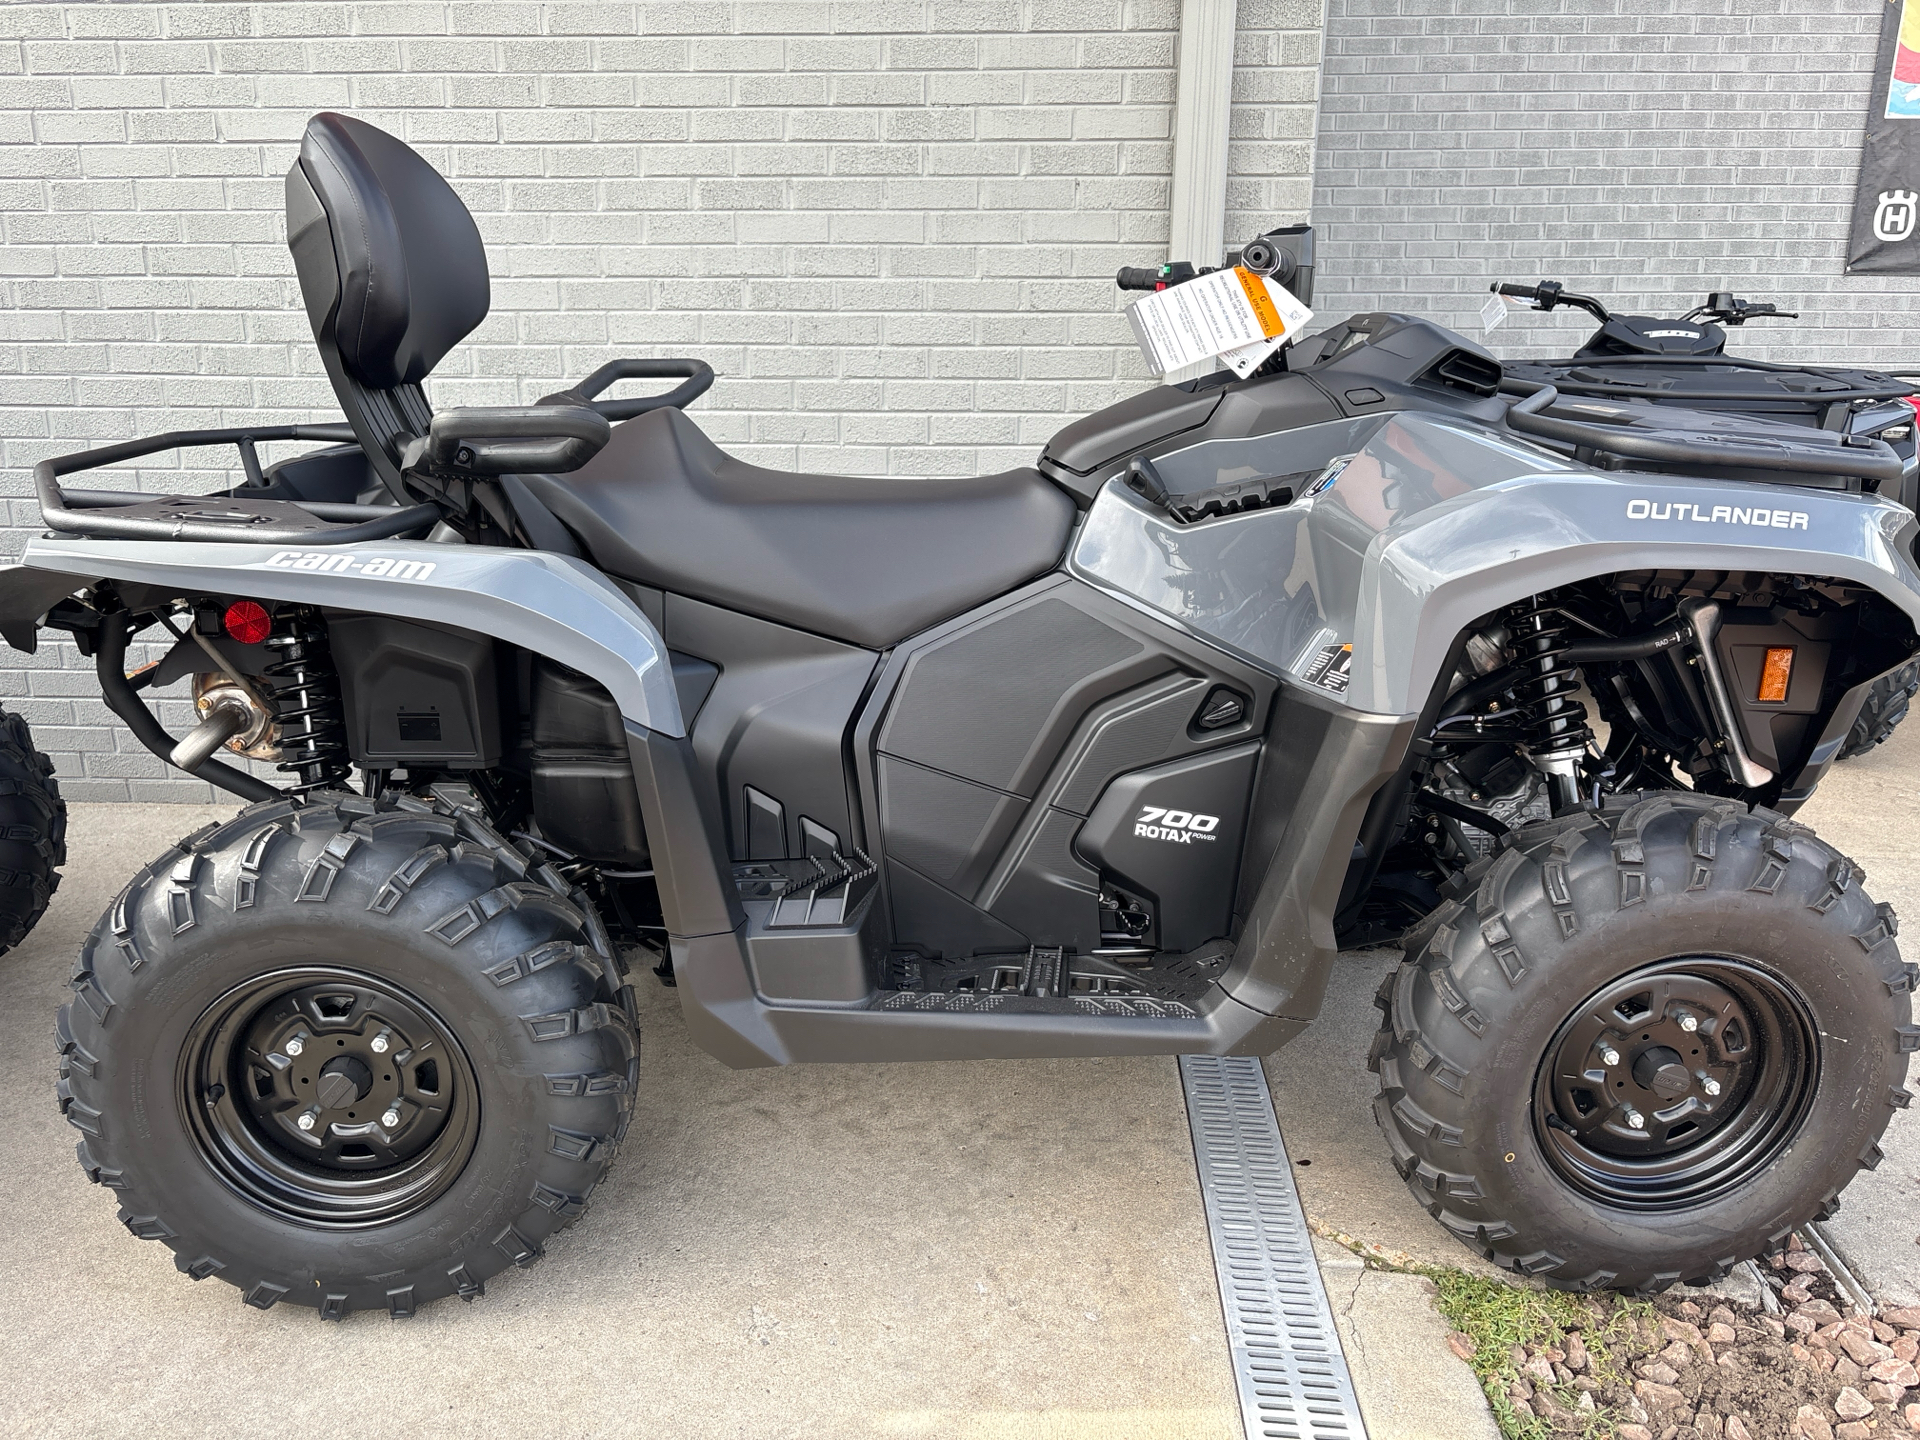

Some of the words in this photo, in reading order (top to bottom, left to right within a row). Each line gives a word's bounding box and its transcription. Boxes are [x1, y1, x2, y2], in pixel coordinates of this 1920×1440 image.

[1238, 271, 1255, 297] GENERAL
[1252, 298, 1261, 310] USE
[1257, 310, 1271, 332] MODEL
[1259, 294, 1267, 302] G
[1626, 499, 1809, 531] OUTLANDER
[264, 551, 437, 581] can-am
[1654, 638, 1669, 648] RAD
[1137, 805, 1220, 832] 700
[1134, 823, 1192, 844] ROTAX
[1191, 832, 1216, 841] POWER
